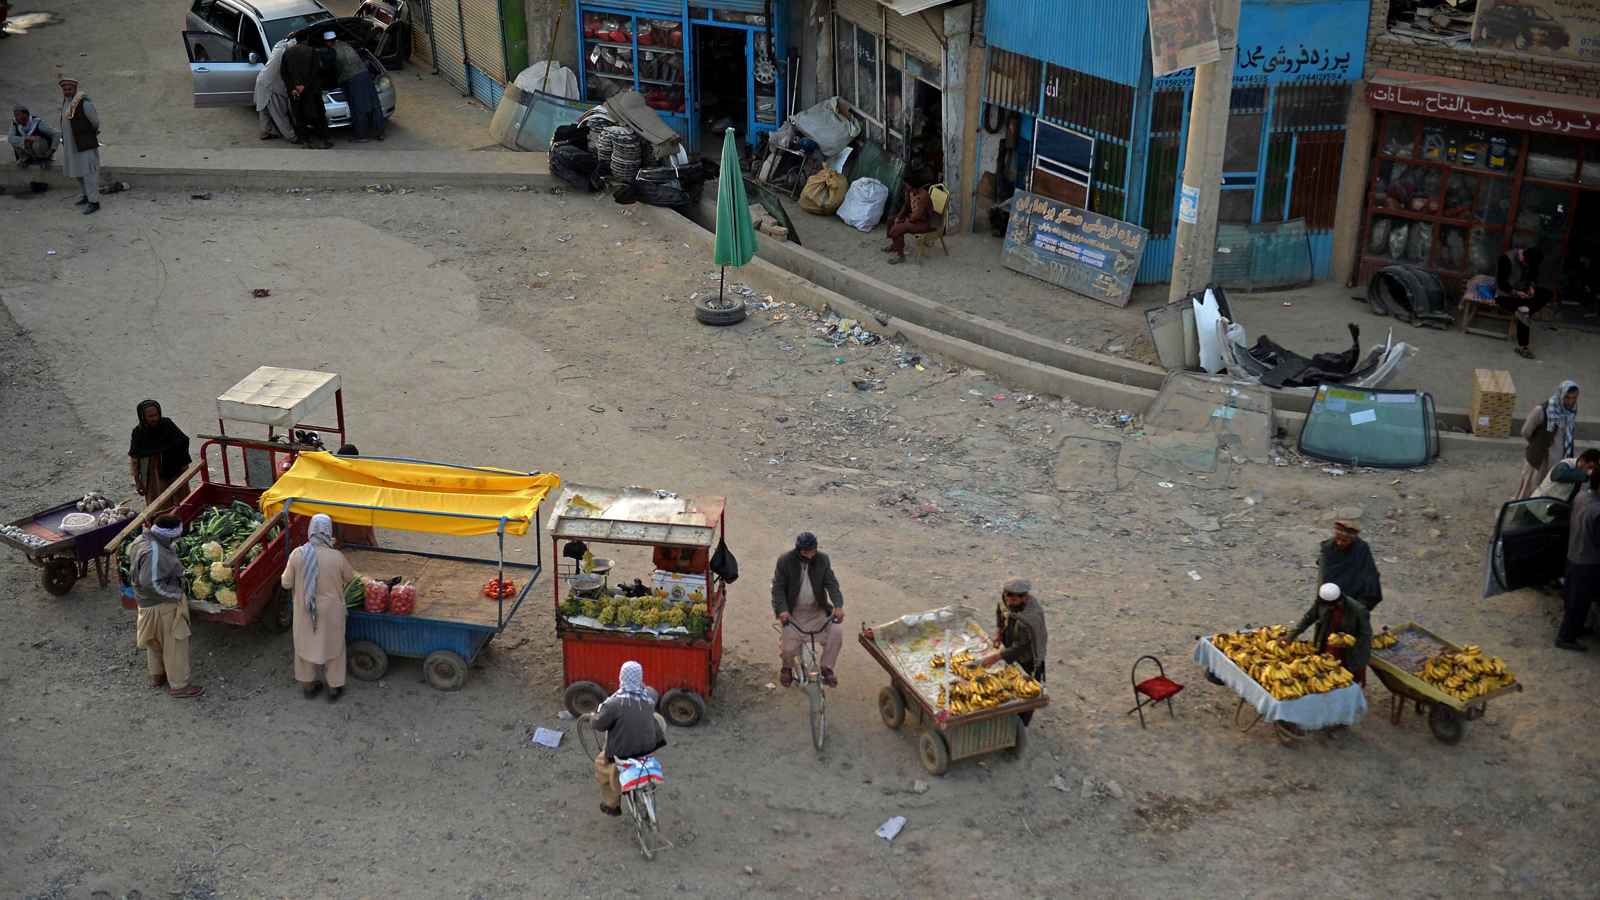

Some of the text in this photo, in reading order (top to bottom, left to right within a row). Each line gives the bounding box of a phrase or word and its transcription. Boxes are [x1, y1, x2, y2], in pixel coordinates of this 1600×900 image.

[1263, 44, 1309, 73] فروشی
[1373, 85, 1420, 107] سادات
[1498, 105, 1524, 123] سید
[1528, 109, 1592, 132] فروشی
